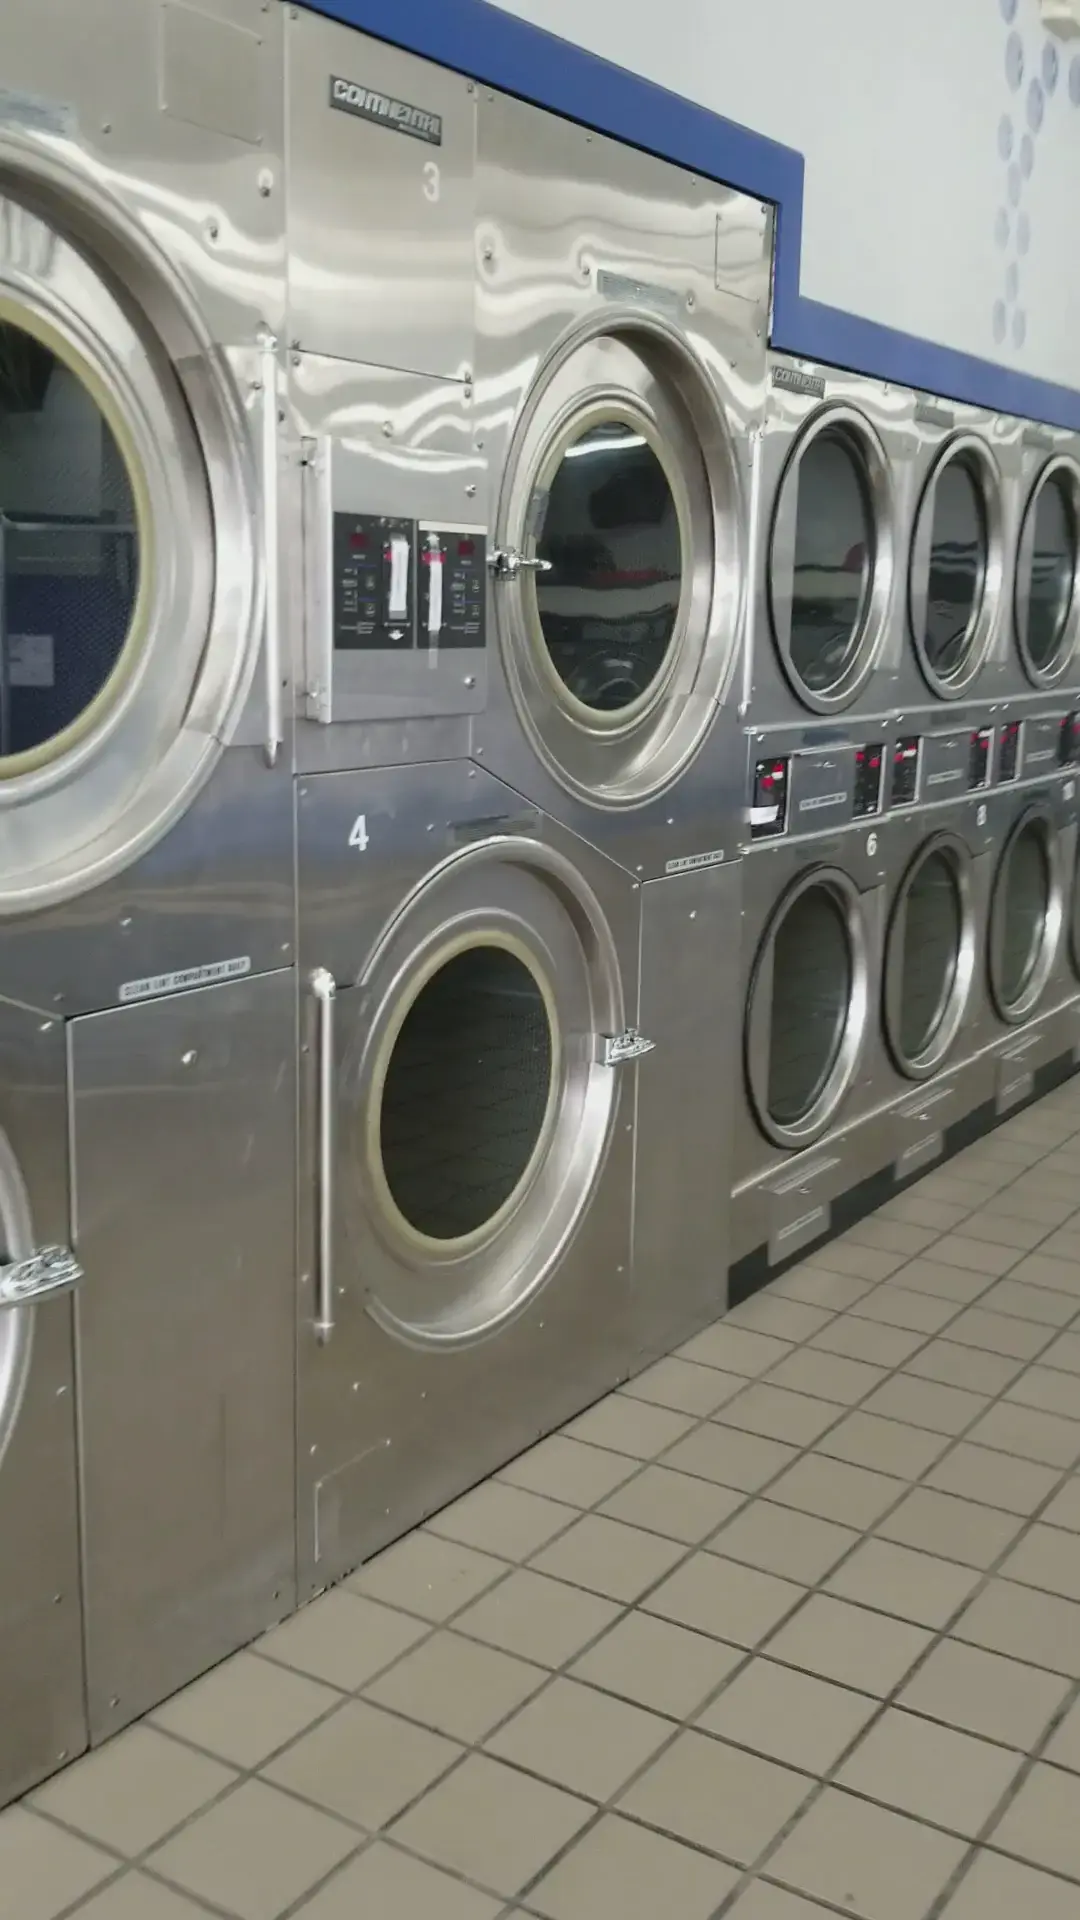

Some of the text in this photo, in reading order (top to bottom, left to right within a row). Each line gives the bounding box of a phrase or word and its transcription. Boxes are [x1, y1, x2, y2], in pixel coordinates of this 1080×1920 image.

[334, 79, 441, 136] CONTINENTAL
[422, 161, 440, 203] 3
[347, 814, 370, 852] 4
[975, 803, 988, 827] 8
[865, 831, 879, 857] 6
